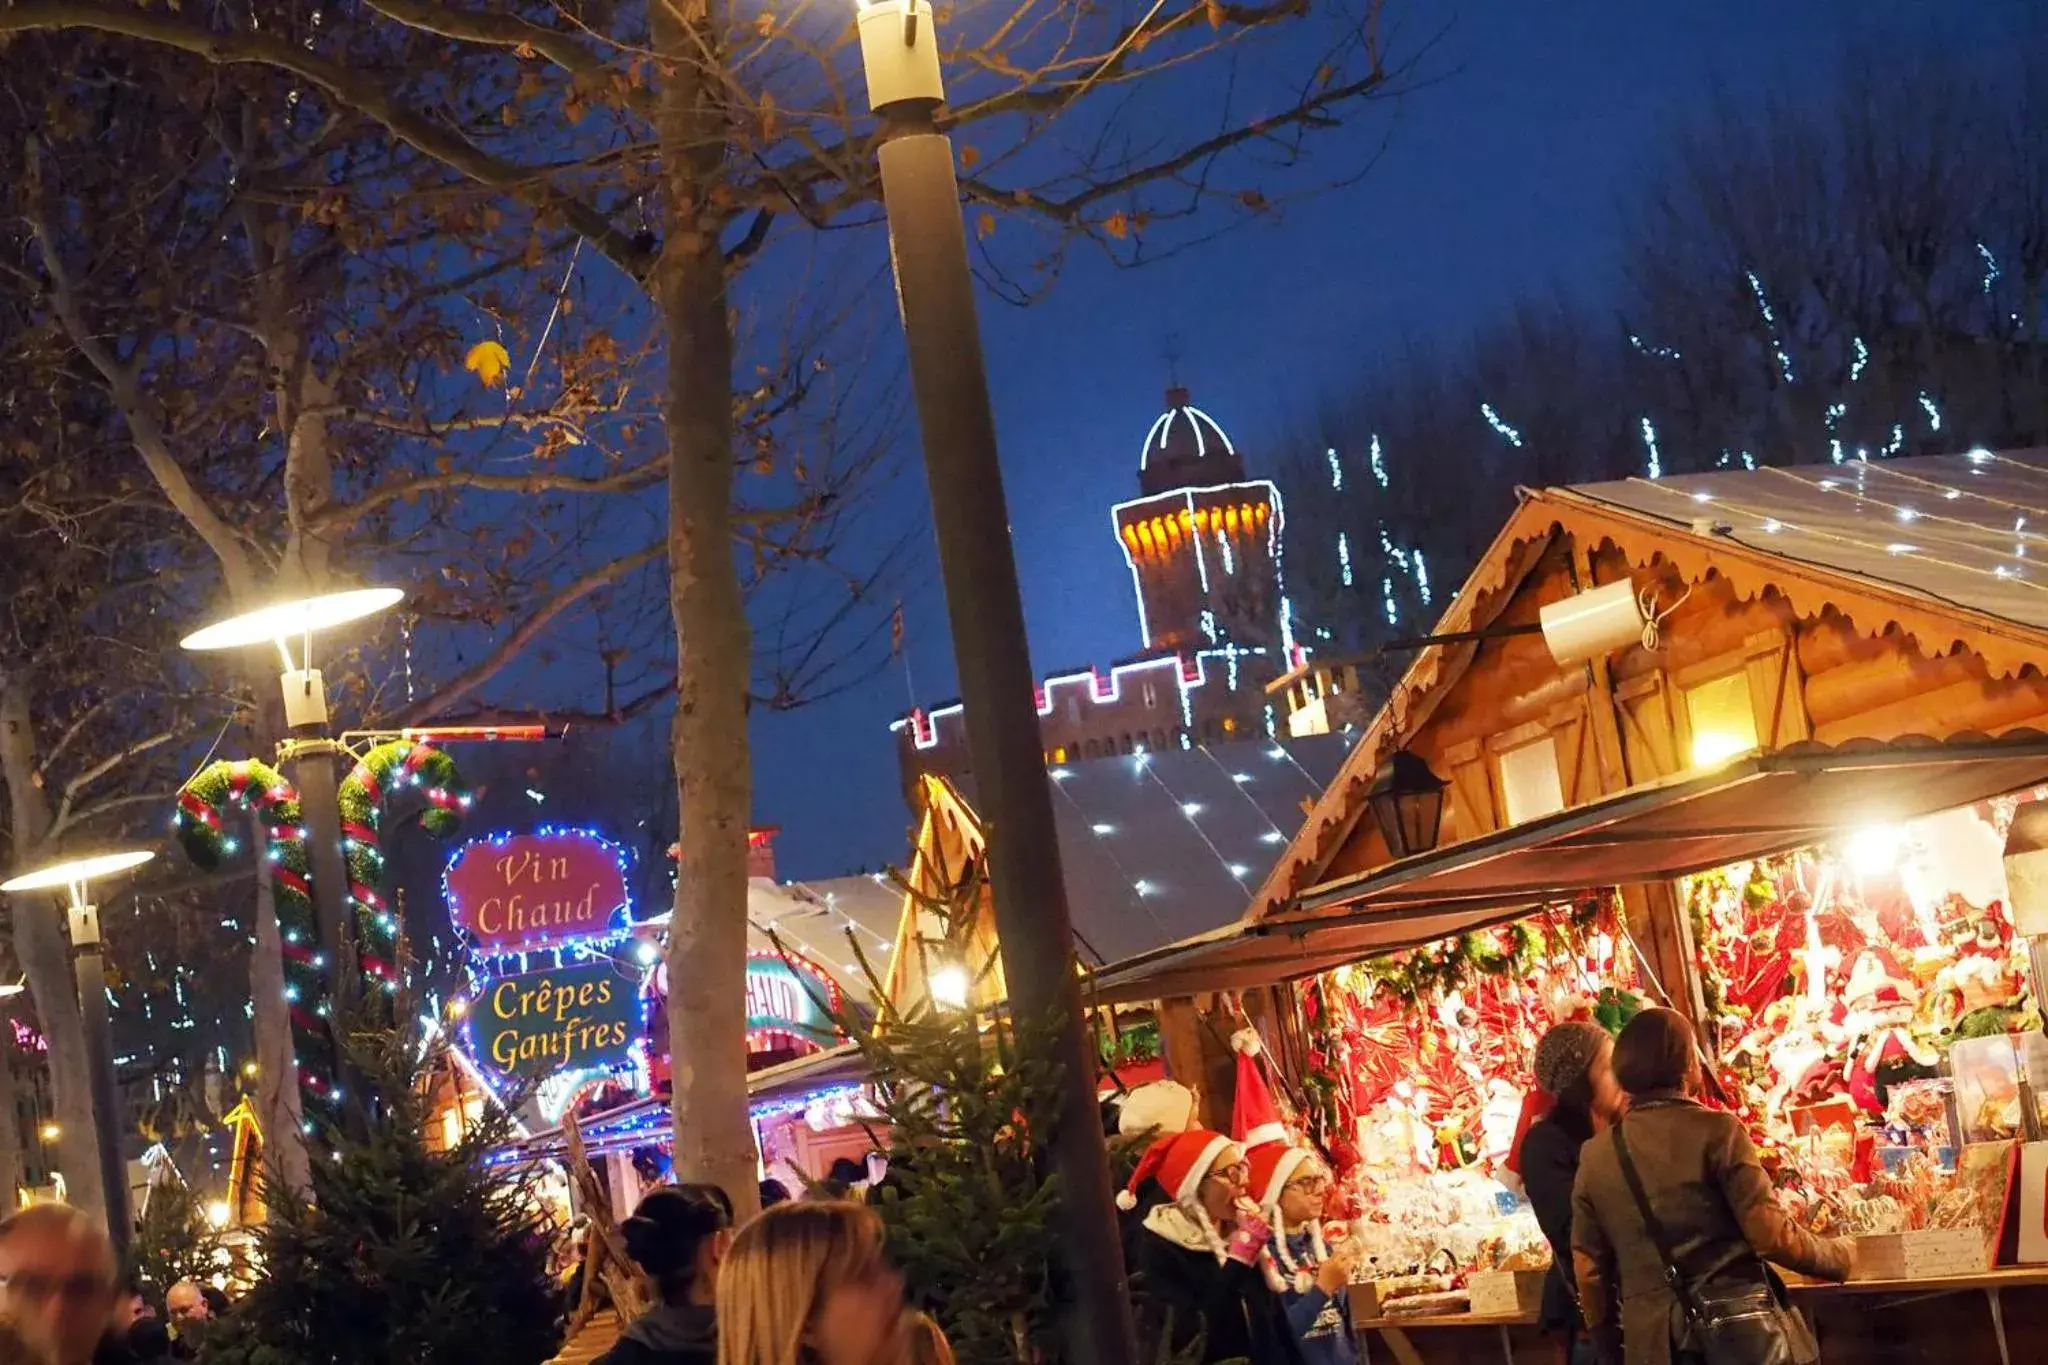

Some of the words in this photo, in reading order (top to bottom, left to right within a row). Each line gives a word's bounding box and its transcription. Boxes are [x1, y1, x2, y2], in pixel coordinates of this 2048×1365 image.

[496, 851, 569, 885] Vin
[478, 884, 600, 934] Chaud
[493, 978, 612, 1022] Crêpes
[492, 1015, 627, 1074] Gaufres
